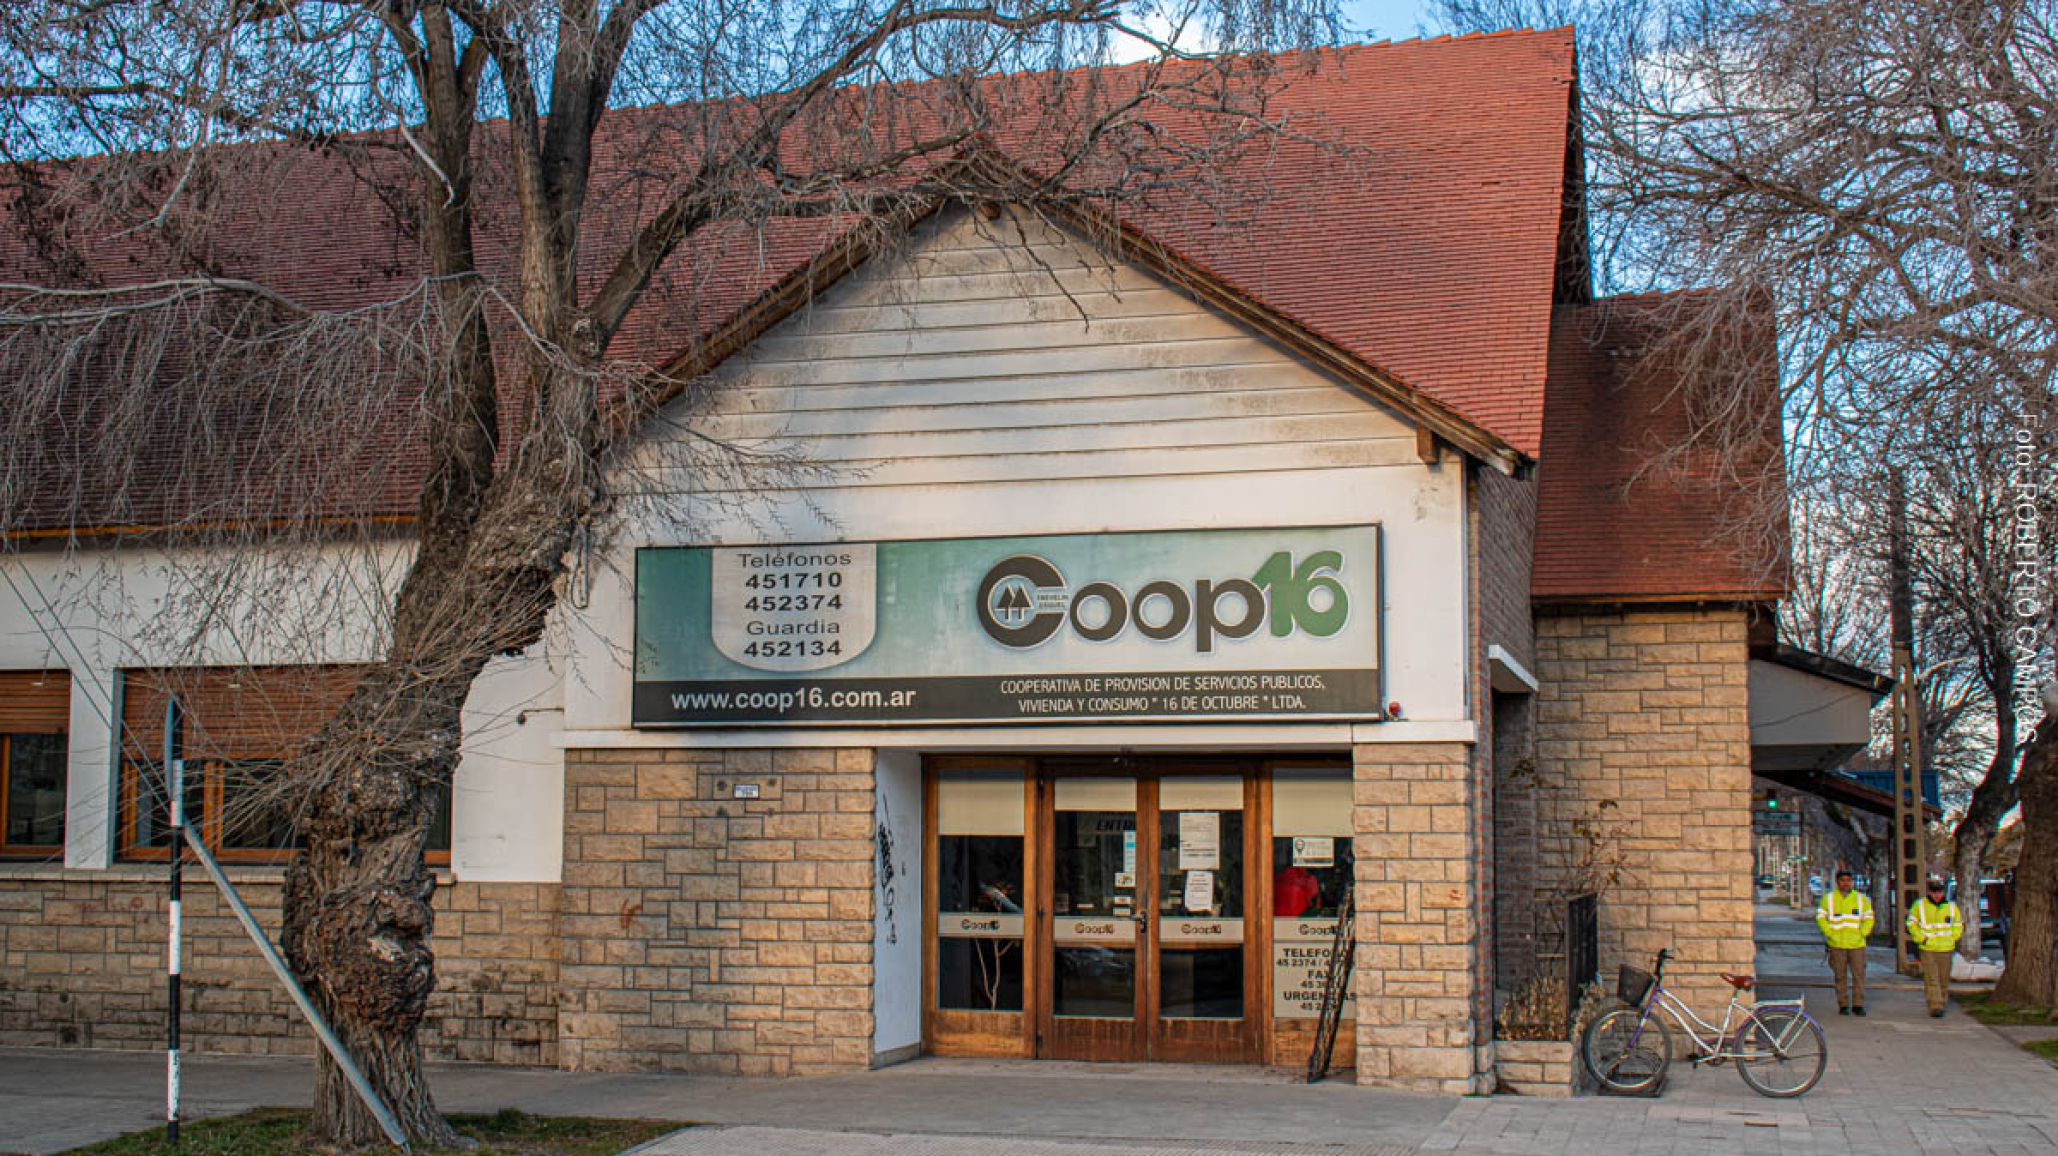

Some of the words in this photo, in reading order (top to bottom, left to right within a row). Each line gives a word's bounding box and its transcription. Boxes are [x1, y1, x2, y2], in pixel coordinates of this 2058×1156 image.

[738, 551, 851, 569] Teléfonos
[745, 572, 842, 589] 451710
[745, 594, 842, 611] 452374
[976, 550, 1350, 653] Coop16
[746, 619, 840, 635] Guardia
[744, 640, 842, 657] 452134
[1001, 678, 1081, 694] COOPERATIVA
[1085, 678, 1101, 692] DE
[1105, 677, 1170, 692] PROVISION
[1174, 677, 1190, 690] DE
[1194, 676, 1258, 690] SERVICIOS
[671, 687, 917, 712] www.coop16.com.ar
[1018, 699, 1073, 713] VIVIENDA
[1077, 698, 1085, 712] Y
[1088, 697, 1149, 712] CONSUMO
[1162, 696, 1178, 711] 16
[1181, 696, 1198, 710] DE
[1201, 695, 1259, 710] OCTUBRE
